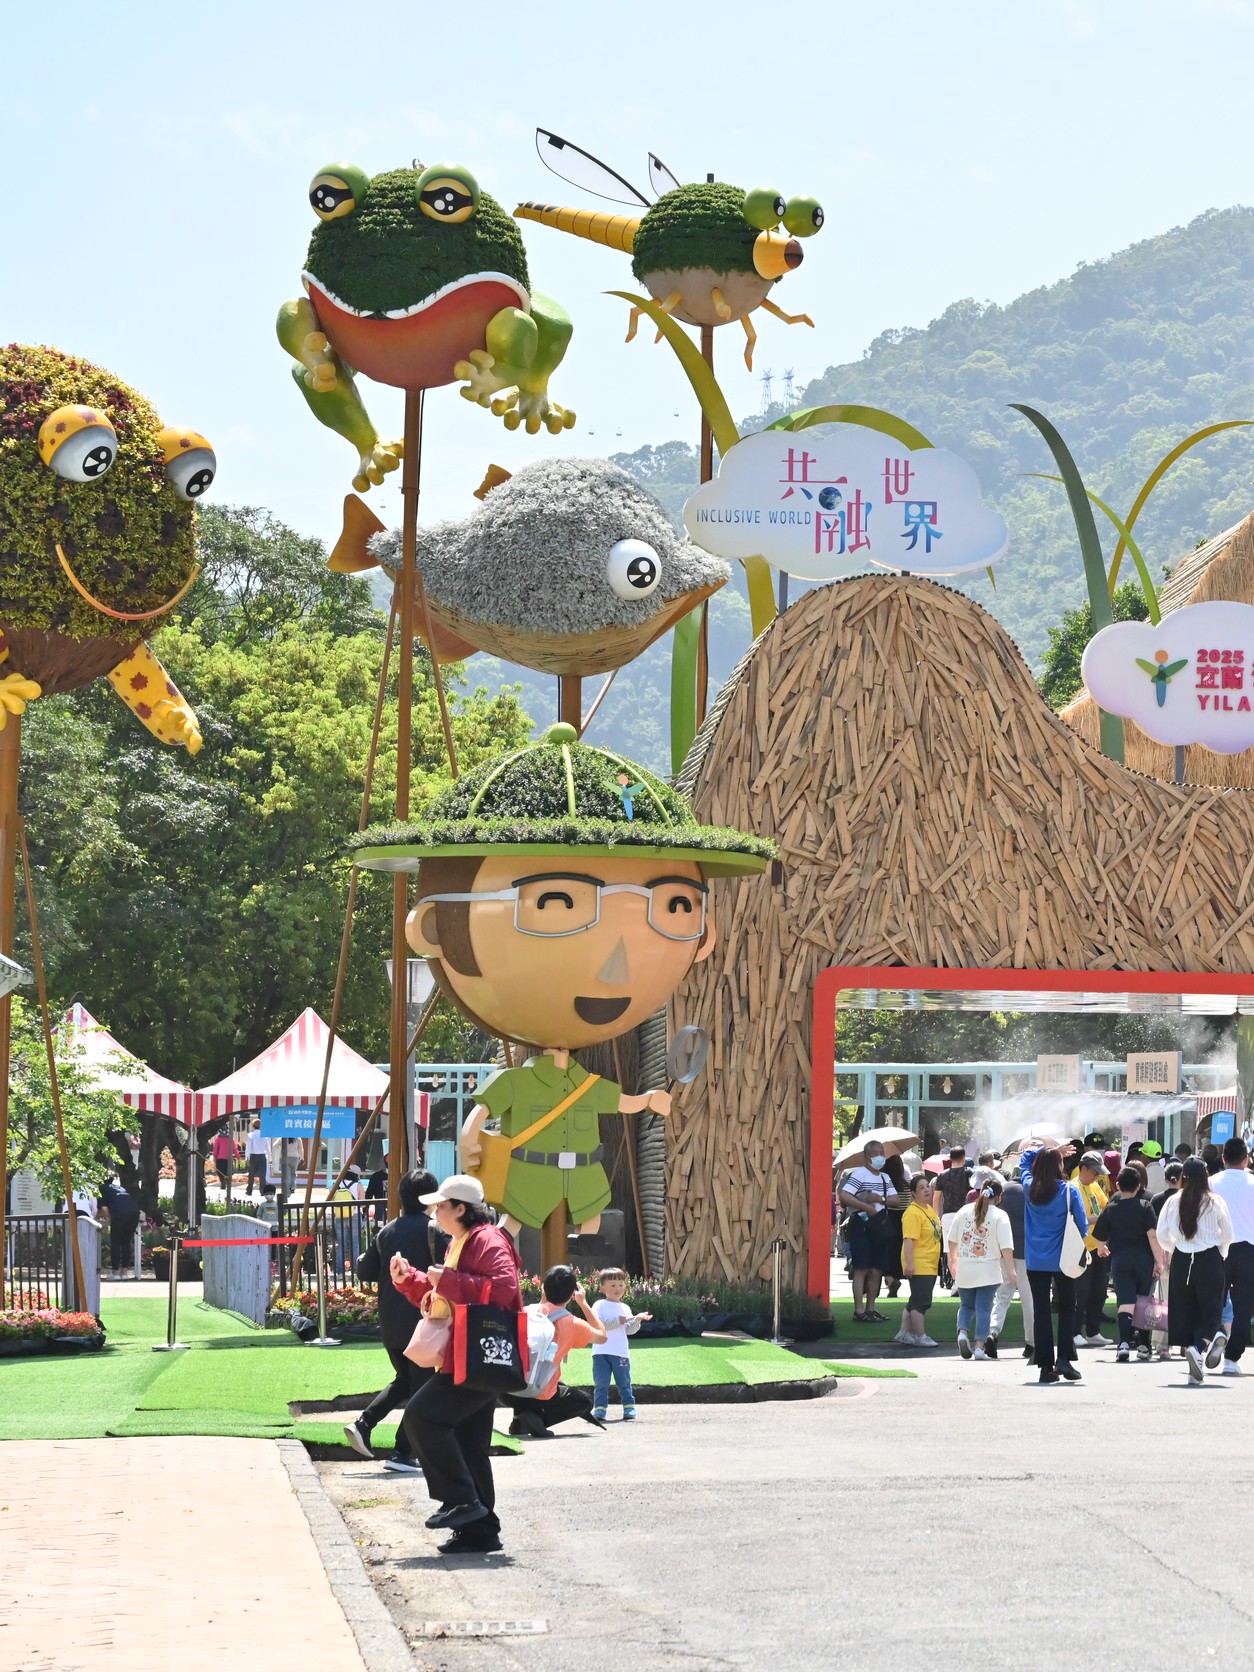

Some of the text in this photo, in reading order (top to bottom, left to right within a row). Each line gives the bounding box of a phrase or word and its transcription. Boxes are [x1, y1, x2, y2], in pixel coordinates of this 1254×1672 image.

[696, 508, 812, 525] INCLUSIVE WORLD
[1196, 648, 1245, 664] 2025
[1195, 664, 1245, 690] 宜蘭
[284, 1118, 332, 1129] 貴賓接區
